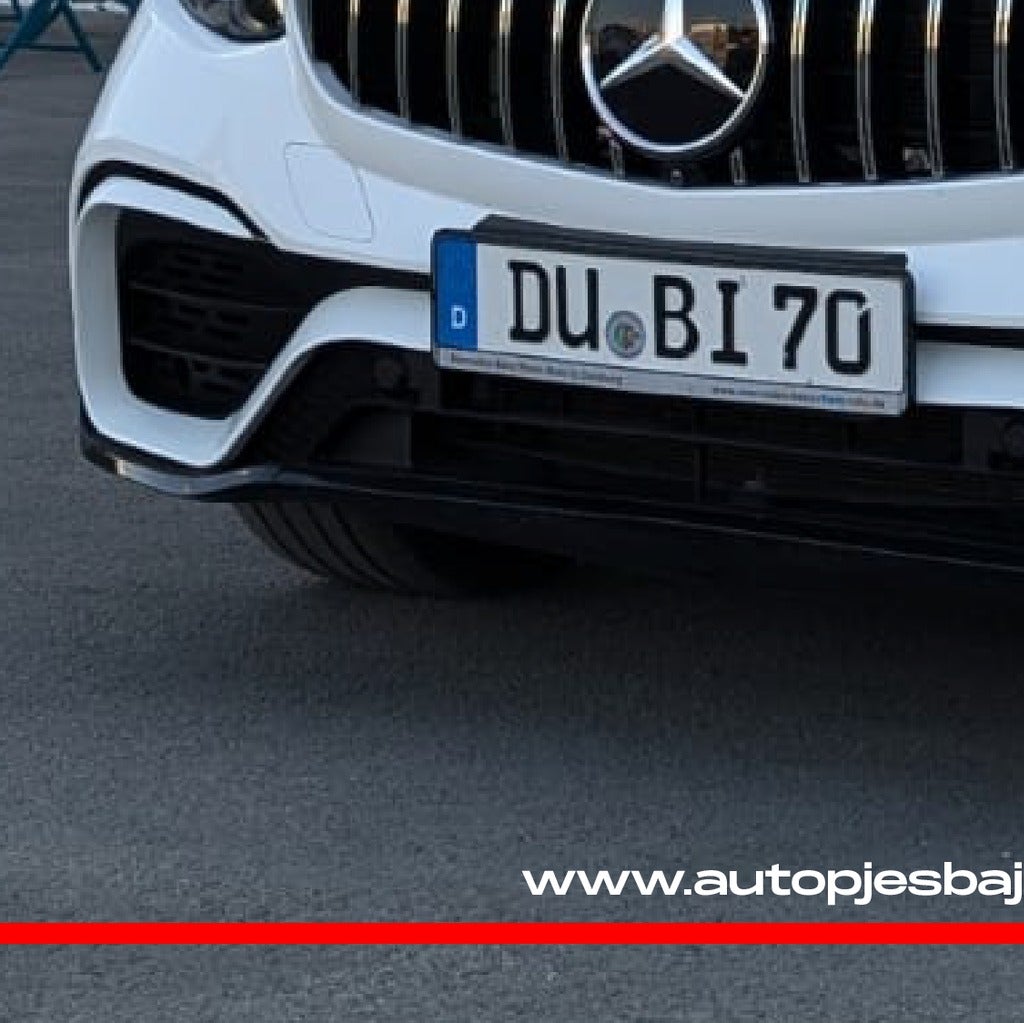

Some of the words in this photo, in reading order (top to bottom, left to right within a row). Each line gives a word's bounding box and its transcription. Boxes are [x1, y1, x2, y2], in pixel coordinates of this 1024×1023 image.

[450, 305, 466, 329] D
[507, 259, 601, 351] DU
[651, 274, 749, 366] BI
[772, 283, 873, 375] 70
